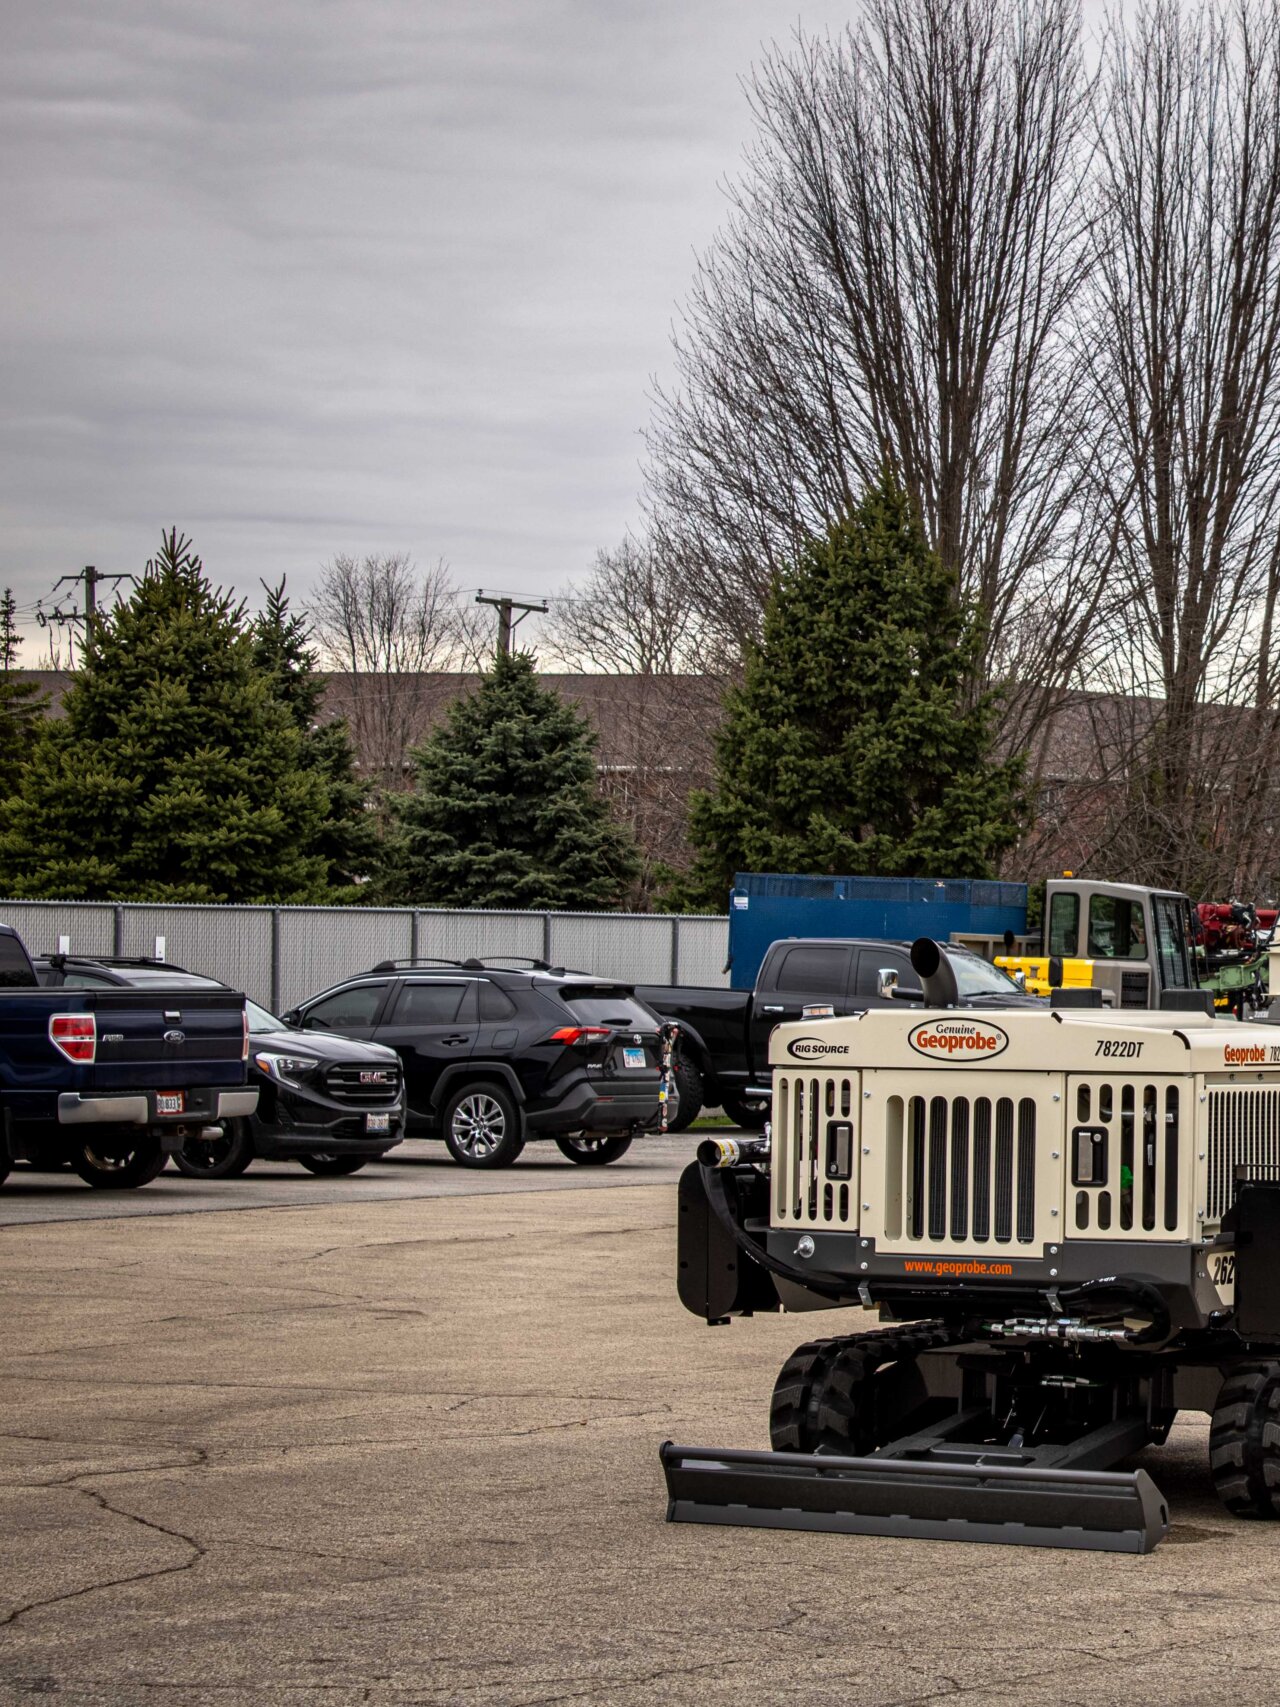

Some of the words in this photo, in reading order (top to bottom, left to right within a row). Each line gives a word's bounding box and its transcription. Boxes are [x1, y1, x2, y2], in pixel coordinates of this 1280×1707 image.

[935, 1023, 976, 1035] Genuine
[794, 1044, 811, 1053] RIG
[811, 1044, 850, 1054] SOURCE
[1094, 1040, 1145, 1059] 7822DT
[360, 1071, 387, 1083] GMC
[904, 1259, 1012, 1278] www.geoprobe.com
